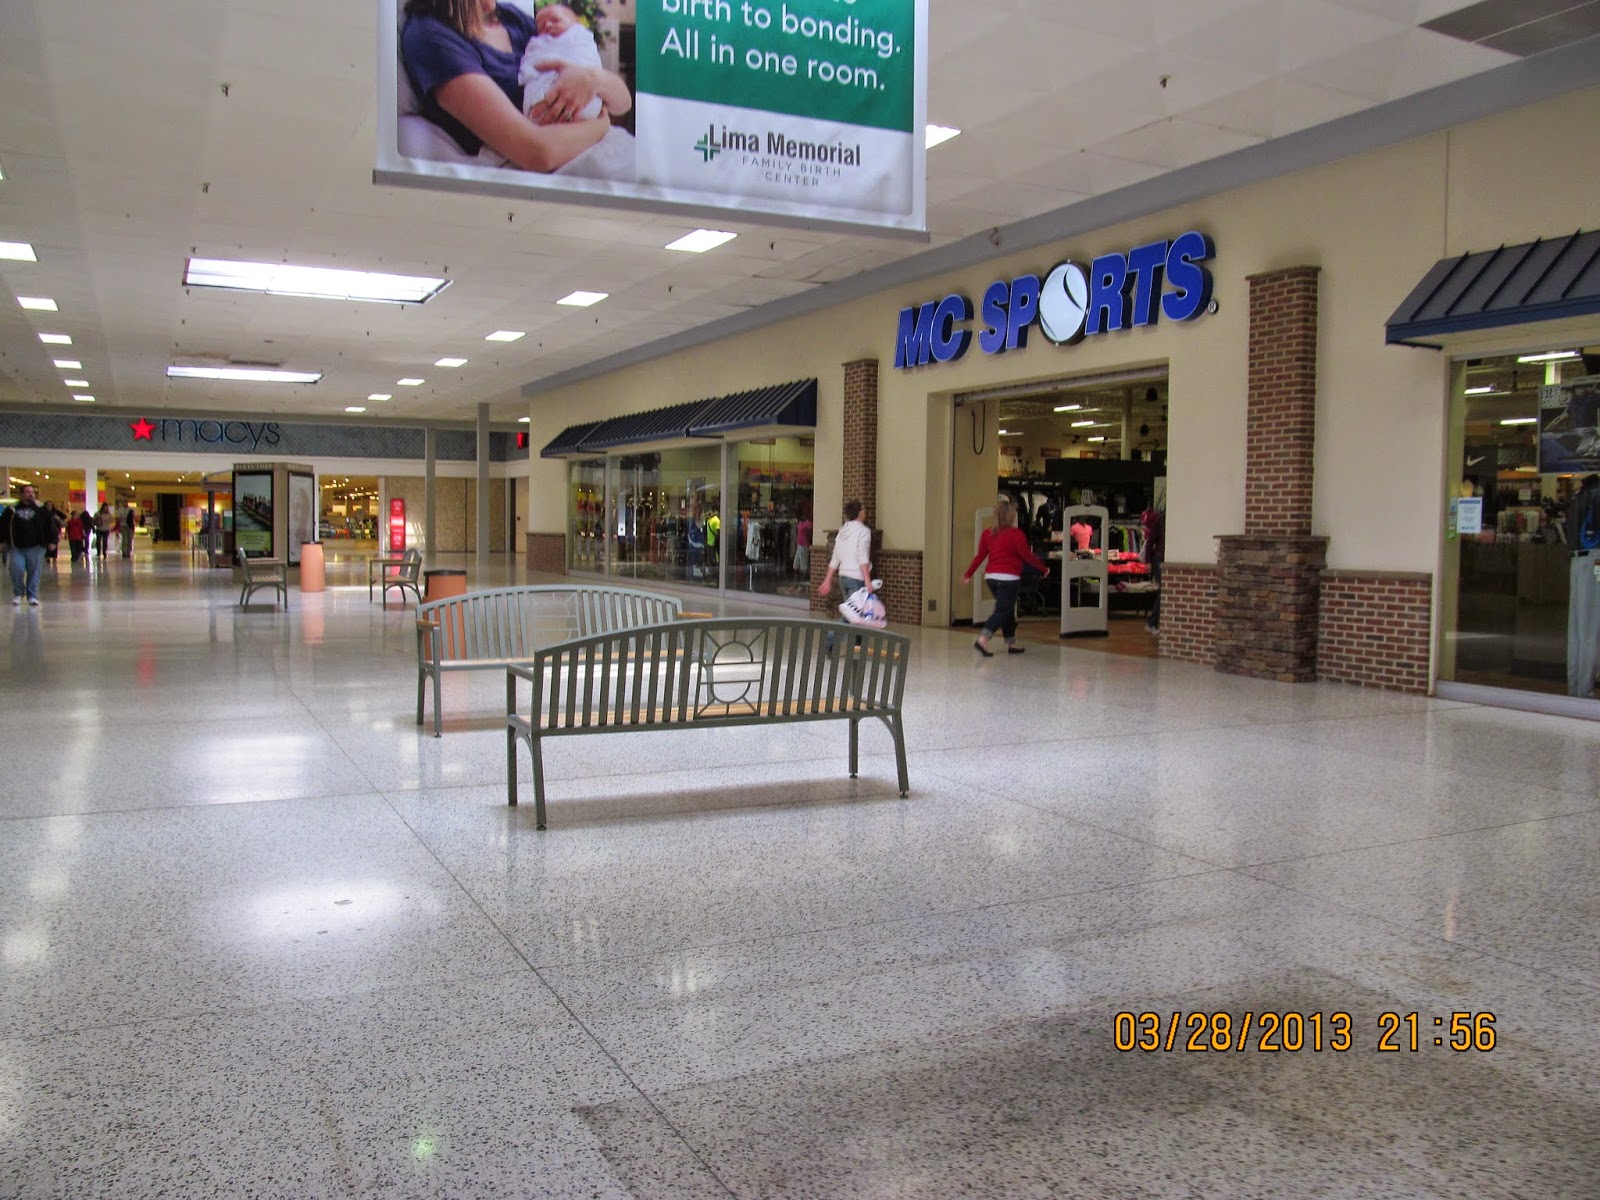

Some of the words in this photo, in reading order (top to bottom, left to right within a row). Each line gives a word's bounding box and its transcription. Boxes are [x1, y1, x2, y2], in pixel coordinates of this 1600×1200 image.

[740, 4, 772, 30] to
[781, 3, 902, 58] bonding.
[660, 27, 700, 61] All
[710, 34, 736, 66] in
[745, 48, 798, 76] one
[807, 58, 886, 91] room.
[709, 123, 760, 153] Lima
[767, 131, 862, 167] Memorial
[742, 156, 793, 172] FAMILY
[800, 165, 842, 178] BIRTH
[765, 171, 820, 188] CENTER
[894, 294, 974, 369] MC
[978, 230, 1216, 355] SPORTS
